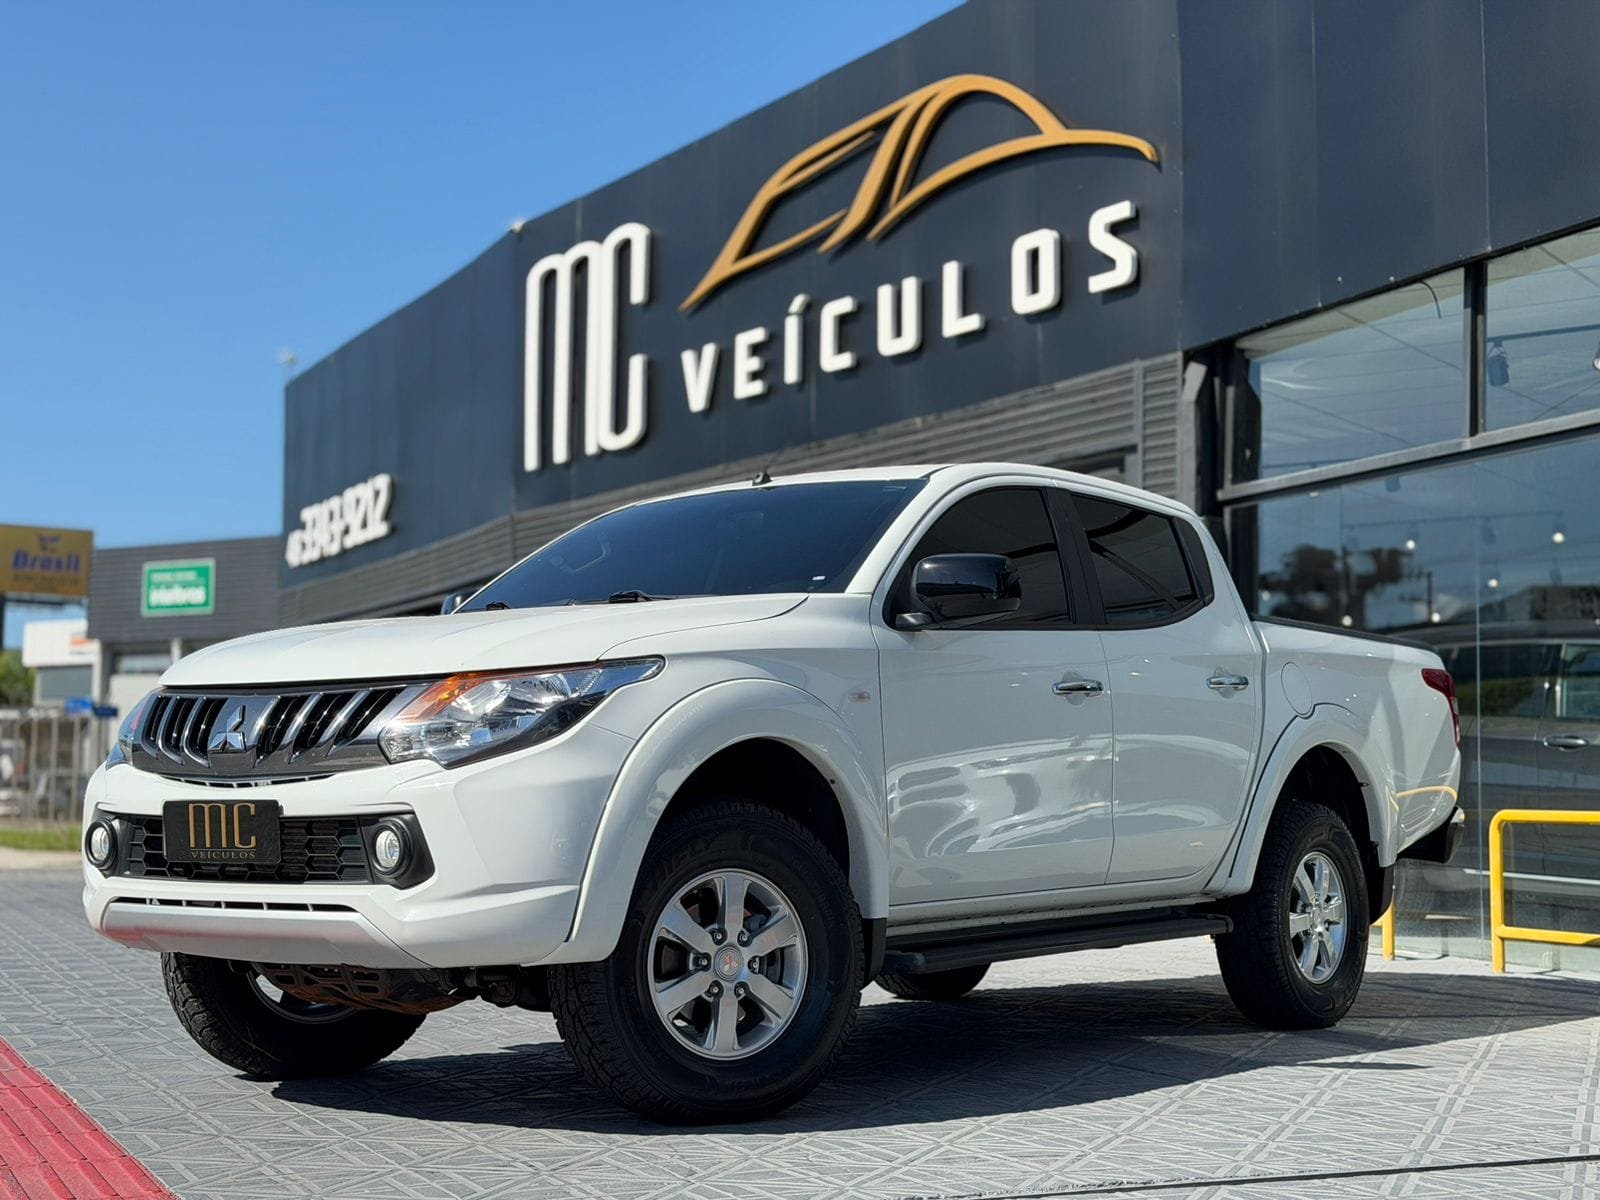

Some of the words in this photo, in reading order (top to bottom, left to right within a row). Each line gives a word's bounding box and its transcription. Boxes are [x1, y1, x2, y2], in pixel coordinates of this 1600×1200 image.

[524, 222, 651, 471] MC
[681, 200, 1137, 412] VEÍCULOS
[188, 802, 256, 848] MC
